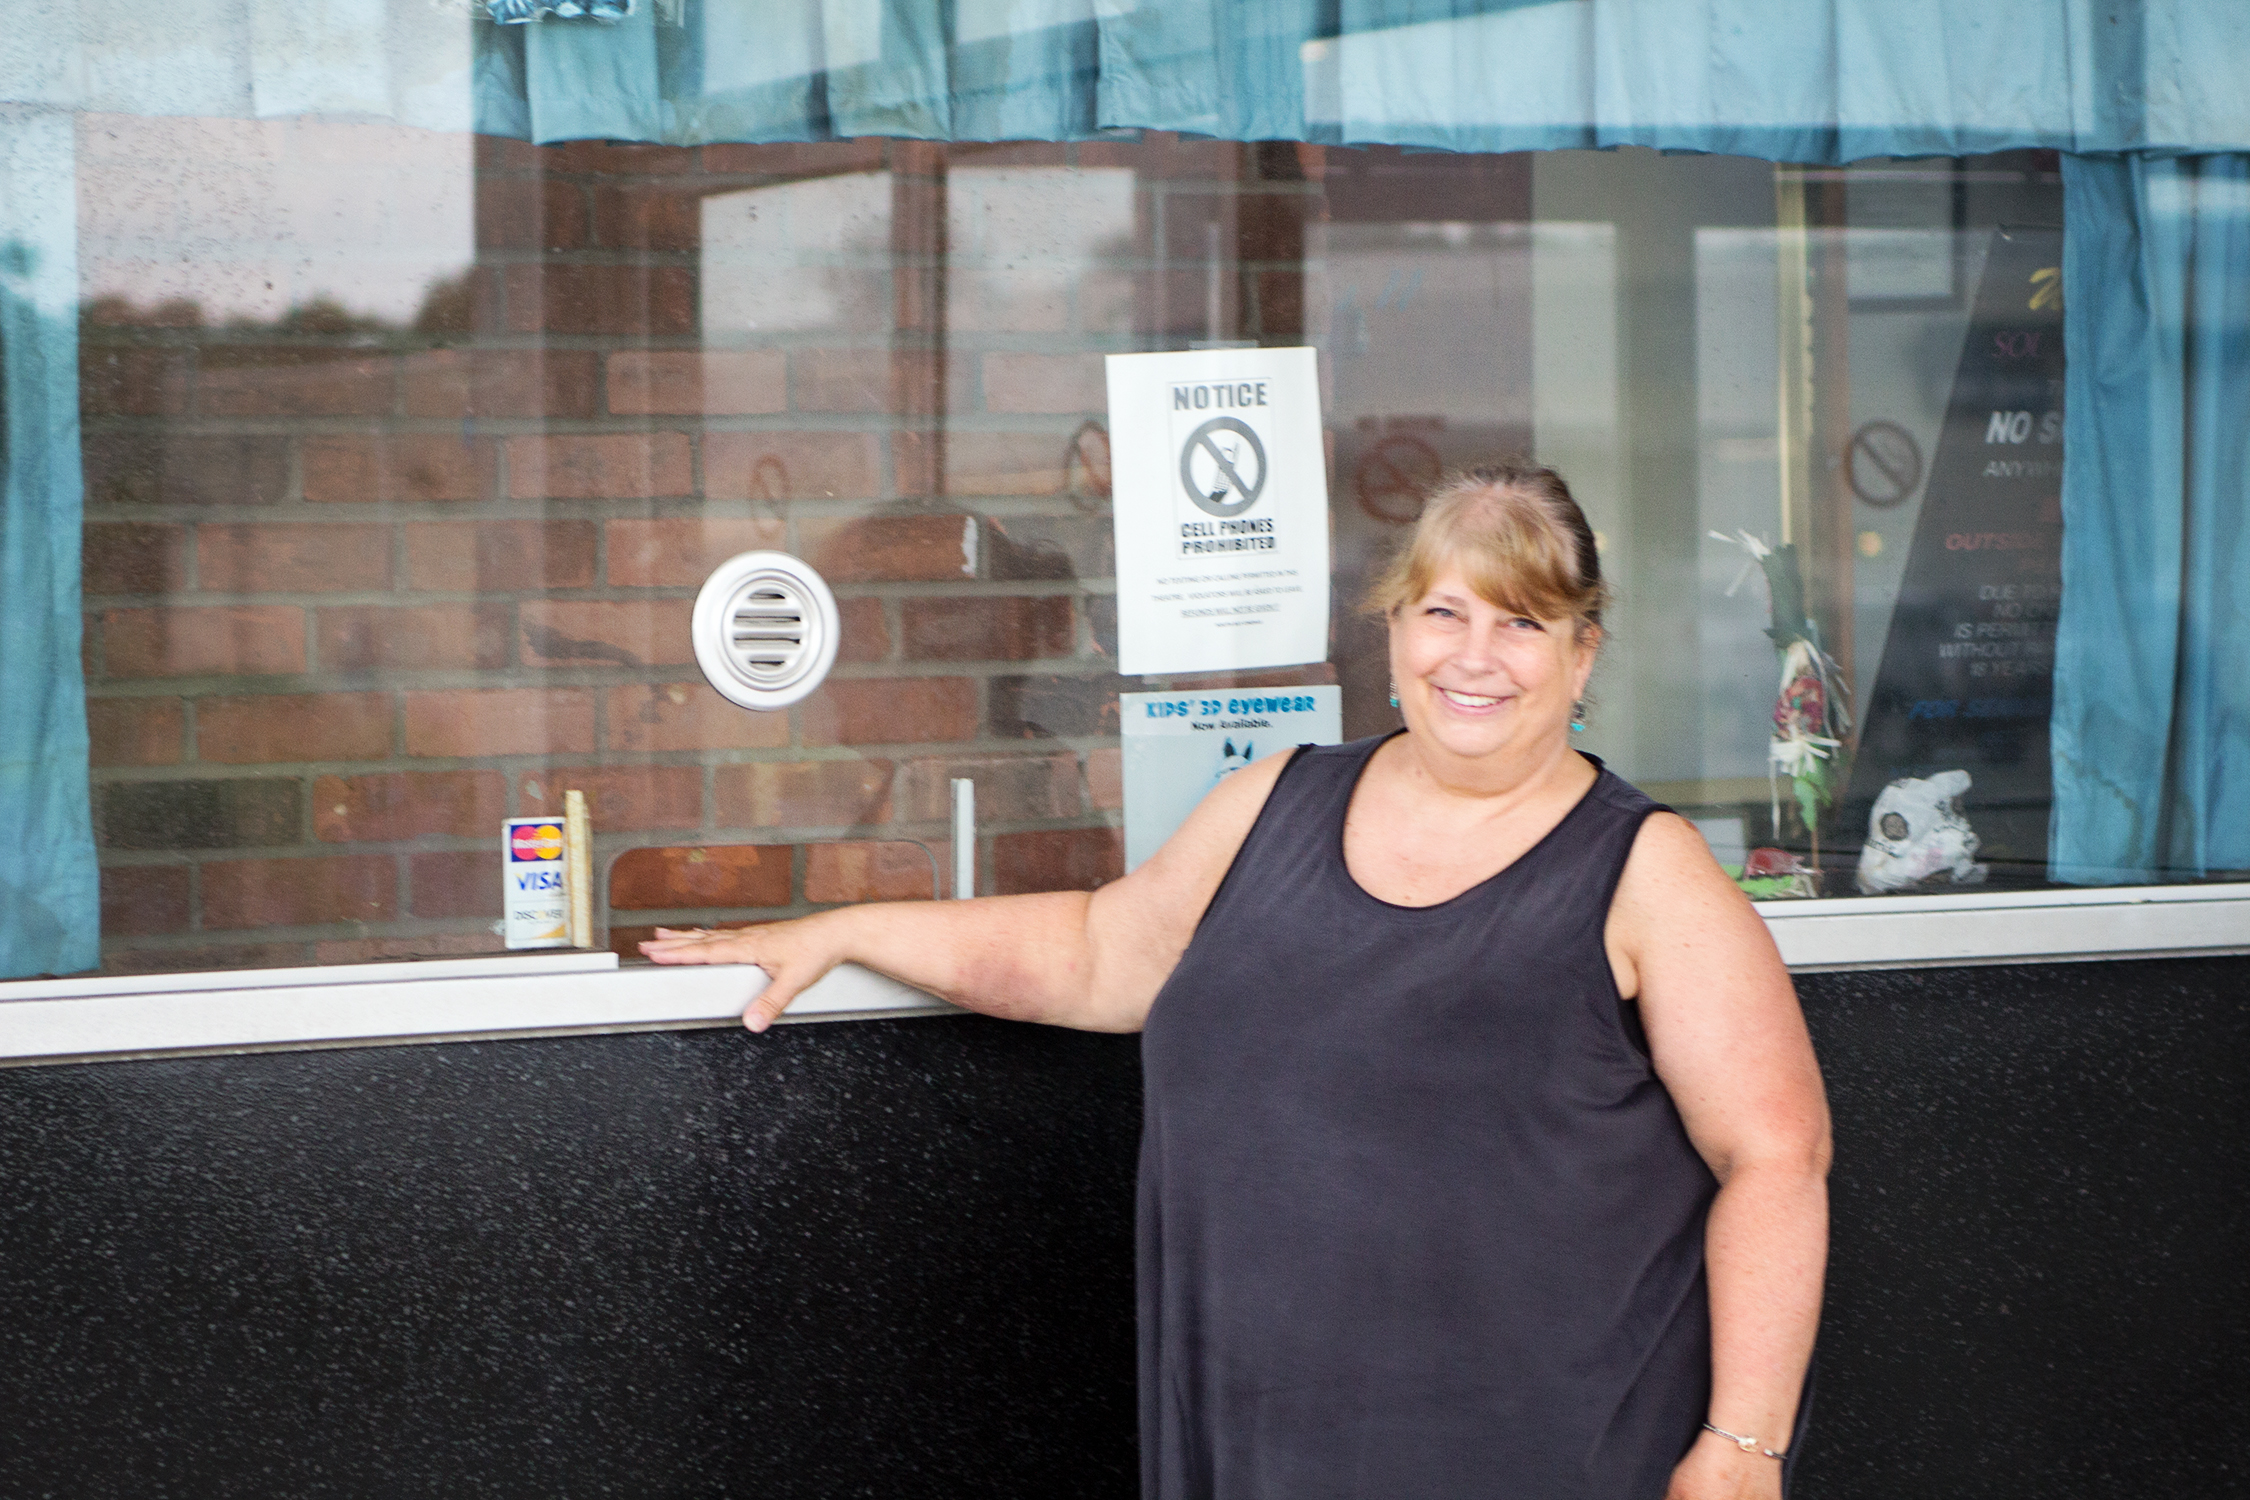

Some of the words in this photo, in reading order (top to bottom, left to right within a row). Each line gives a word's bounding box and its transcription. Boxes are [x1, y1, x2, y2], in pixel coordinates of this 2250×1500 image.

[1174, 383, 1268, 410] NOTICE
[1986, 411, 2032, 444] NO
[2037, 411, 2064, 444] S
[1181, 522, 1214, 538] CELL
[1220, 518, 1274, 535] PHONES
[1182, 536, 1275, 554] PROHIBITED
[1200, 699, 1222, 716] 3D
[1191, 721, 1215, 731] Now
[514, 871, 563, 891] VISA
